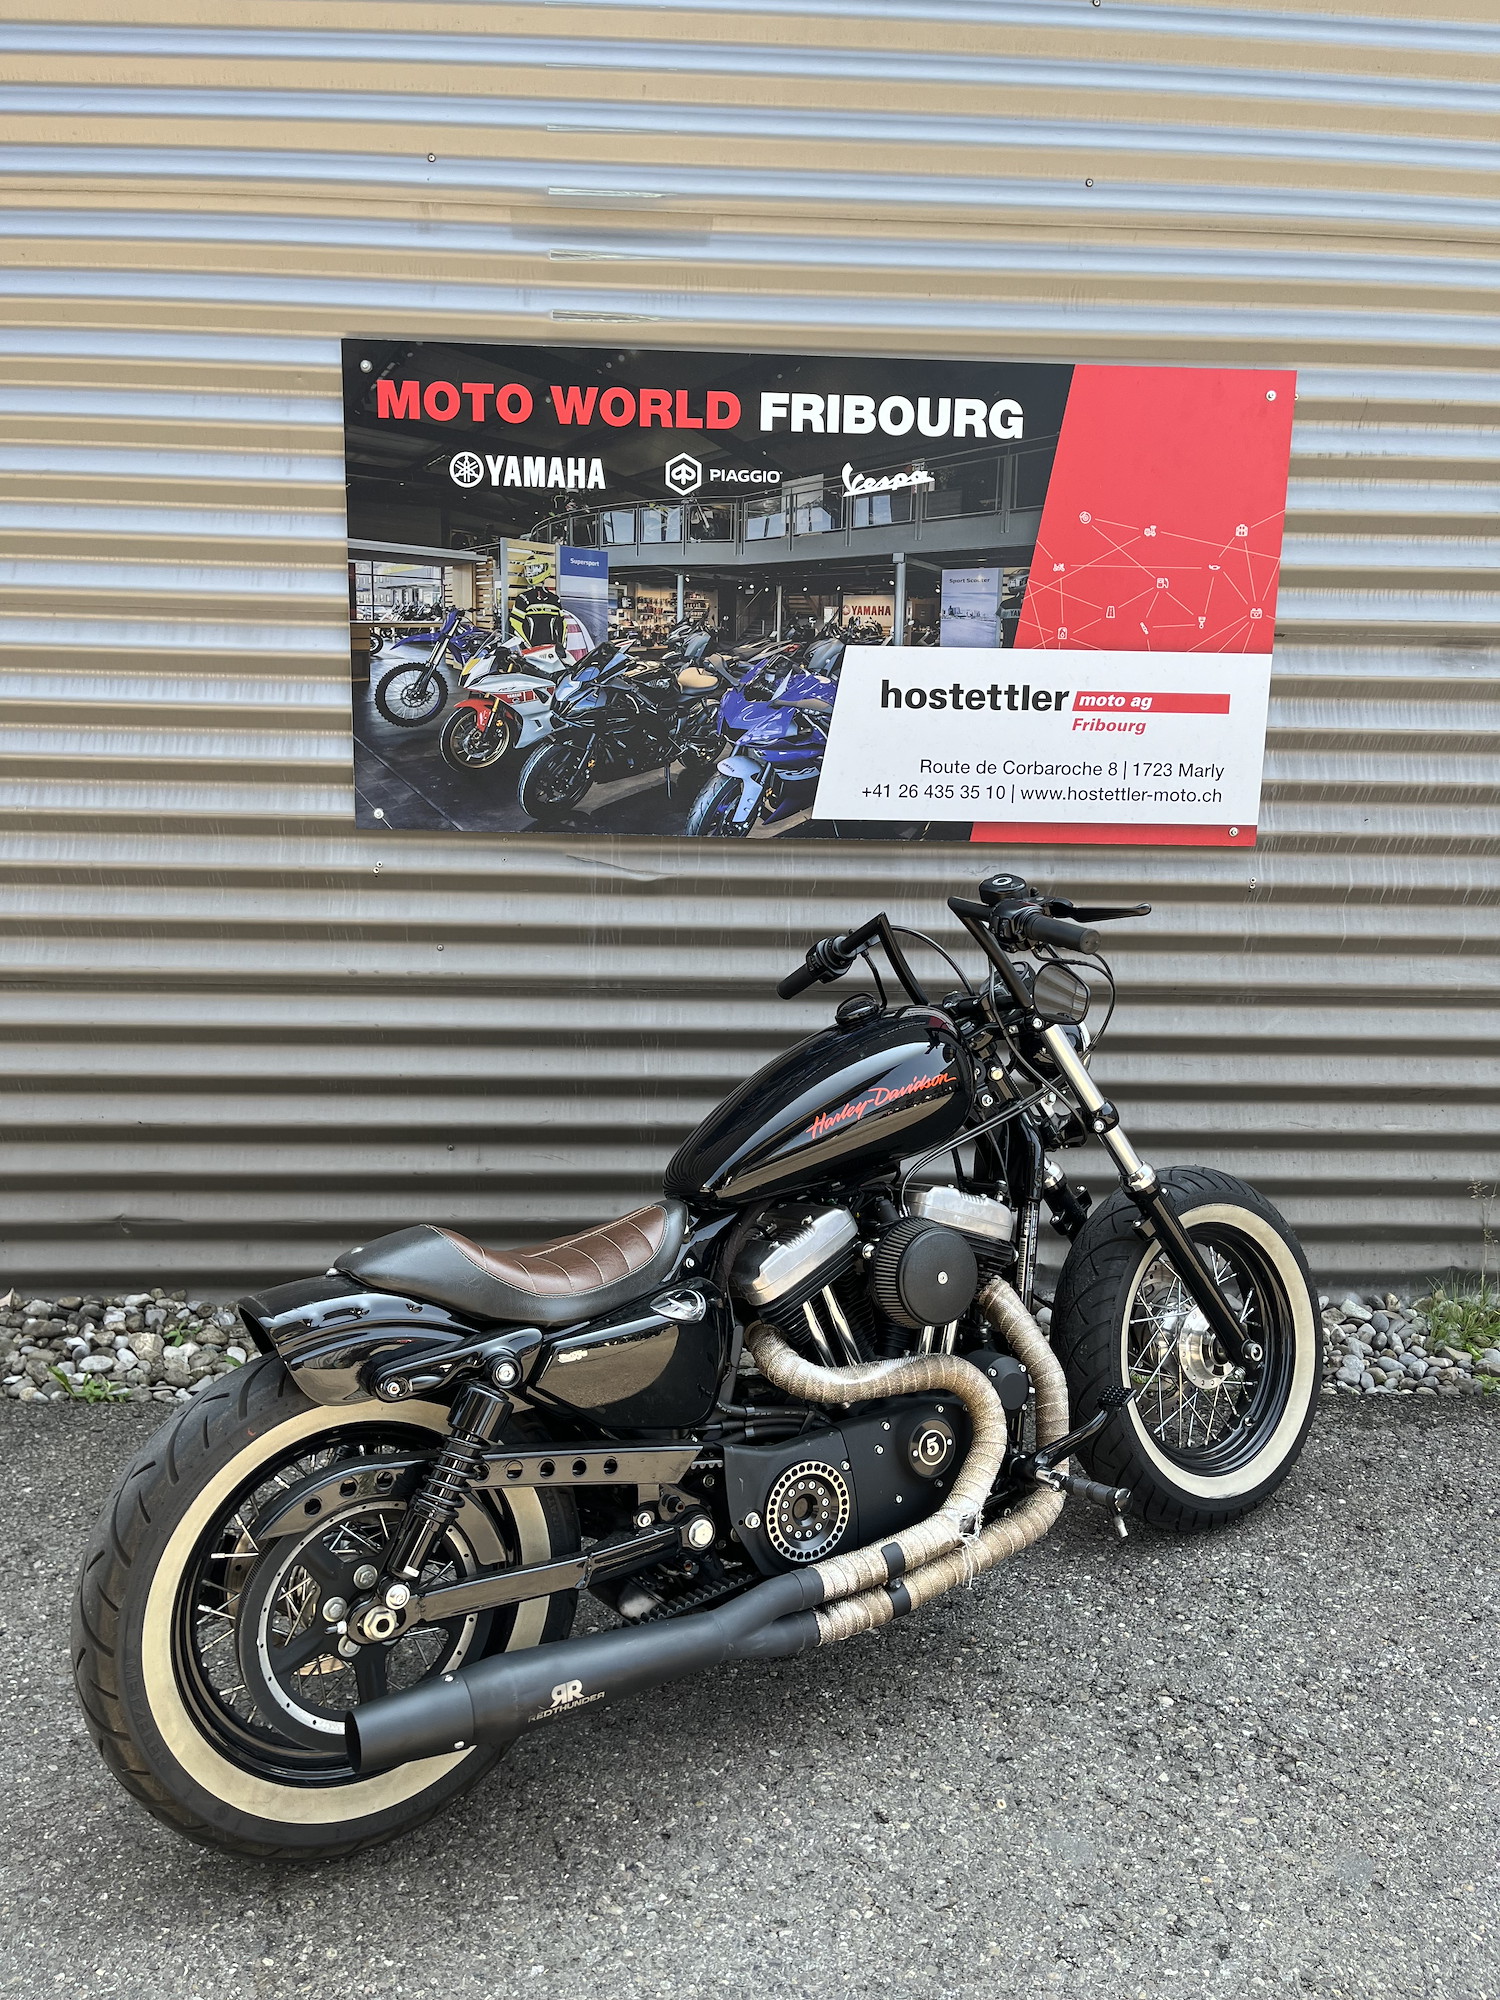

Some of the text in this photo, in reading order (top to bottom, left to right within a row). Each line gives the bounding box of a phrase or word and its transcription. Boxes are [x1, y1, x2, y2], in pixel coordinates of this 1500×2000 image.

[376, 379, 1024, 440] MOTO WORLD FRIBOURG
[485, 455, 606, 490] YAMAHA
[709, 468, 782, 484] PIAGGIO
[841, 462, 935, 497] Vespa
[570, 558, 600, 567] Supersport
[851, 605, 891, 616] YAMAHA
[881, 679, 1153, 711] hostettler moto ag
[1072, 717, 1146, 735] Fribourg
[920, 759, 971, 774] Route
[976, 759, 997, 775] de
[1002, 760, 1103, 776] Corbaroche
[1107, 762, 1118, 776] 8
[1133, 762, 1173, 777] 1723
[1178, 763, 1225, 782] Marly
[862, 784, 890, 798] +41
[898, 784, 918, 799] 26
[924, 784, 954, 799] 435
[960, 785, 980, 800] 35
[986, 785, 1006, 800] 10
[1020, 785, 1222, 803] www.hostettler-moto.ch
[806, 1072, 957, 1139] Harley-Davidson
[926, 1436, 940, 1455] 5
